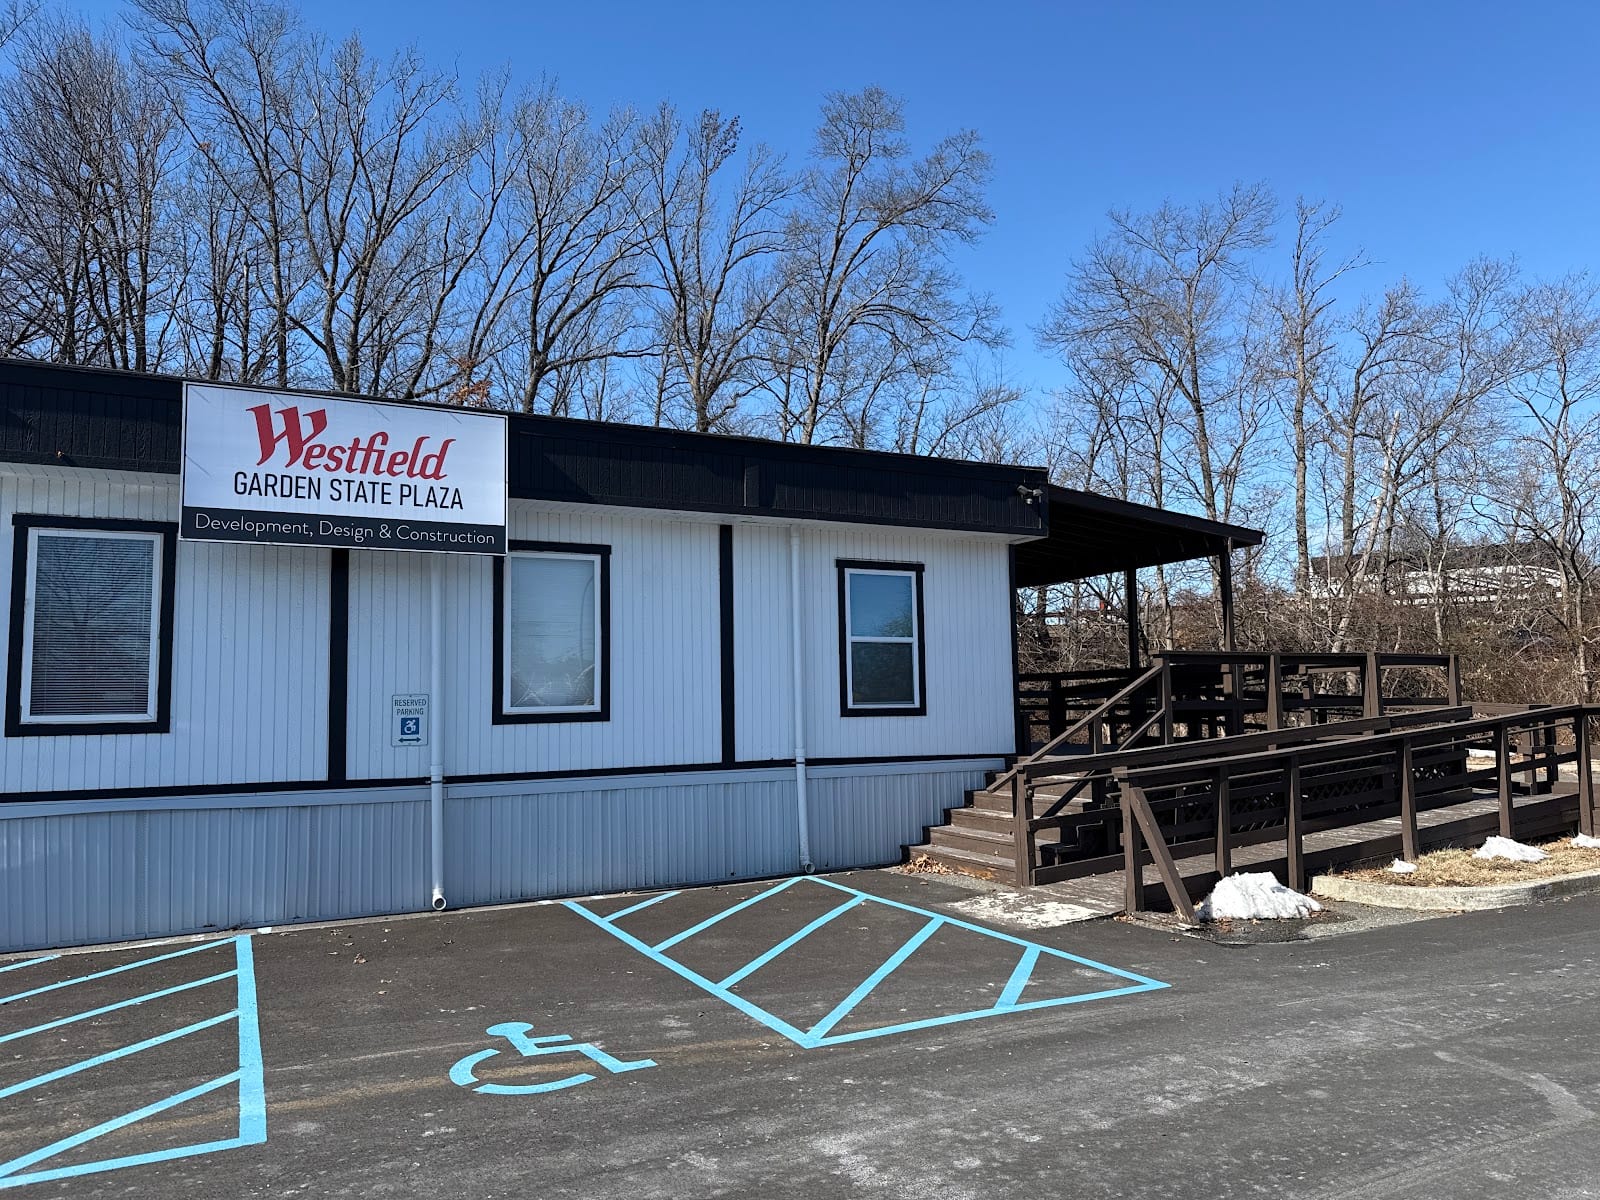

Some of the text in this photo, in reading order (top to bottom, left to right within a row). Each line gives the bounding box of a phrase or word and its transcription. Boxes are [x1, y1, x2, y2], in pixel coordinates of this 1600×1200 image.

[245, 403, 457, 481] Westfield
[233, 471, 464, 510] GARDEN STATE PLAZA
[195, 513, 496, 545] Development, Design & Construction
[394, 699, 427, 707] RESERVED
[396, 708, 424, 716] PARKING
